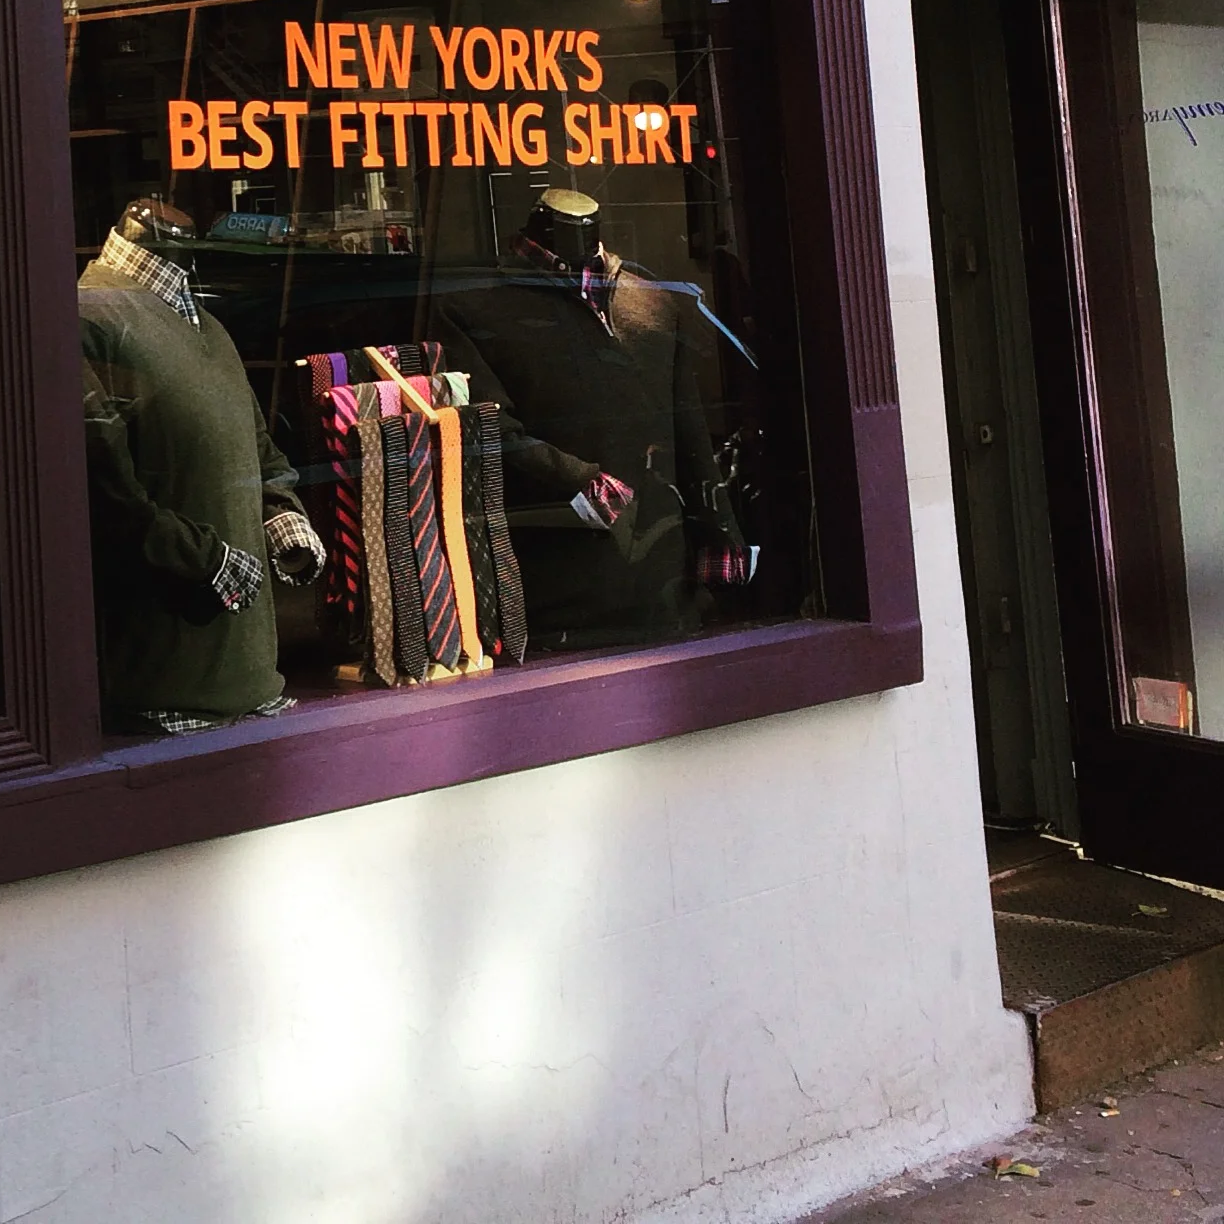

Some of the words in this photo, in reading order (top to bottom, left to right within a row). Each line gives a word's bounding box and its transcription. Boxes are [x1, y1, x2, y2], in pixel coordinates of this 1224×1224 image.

[284, 21, 414, 89] NEW
[429, 26, 603, 93] YORK'S
[168, 100, 309, 170] BEST
[329, 101, 547, 168] FITTING
[564, 103, 697, 167] SHIRT
